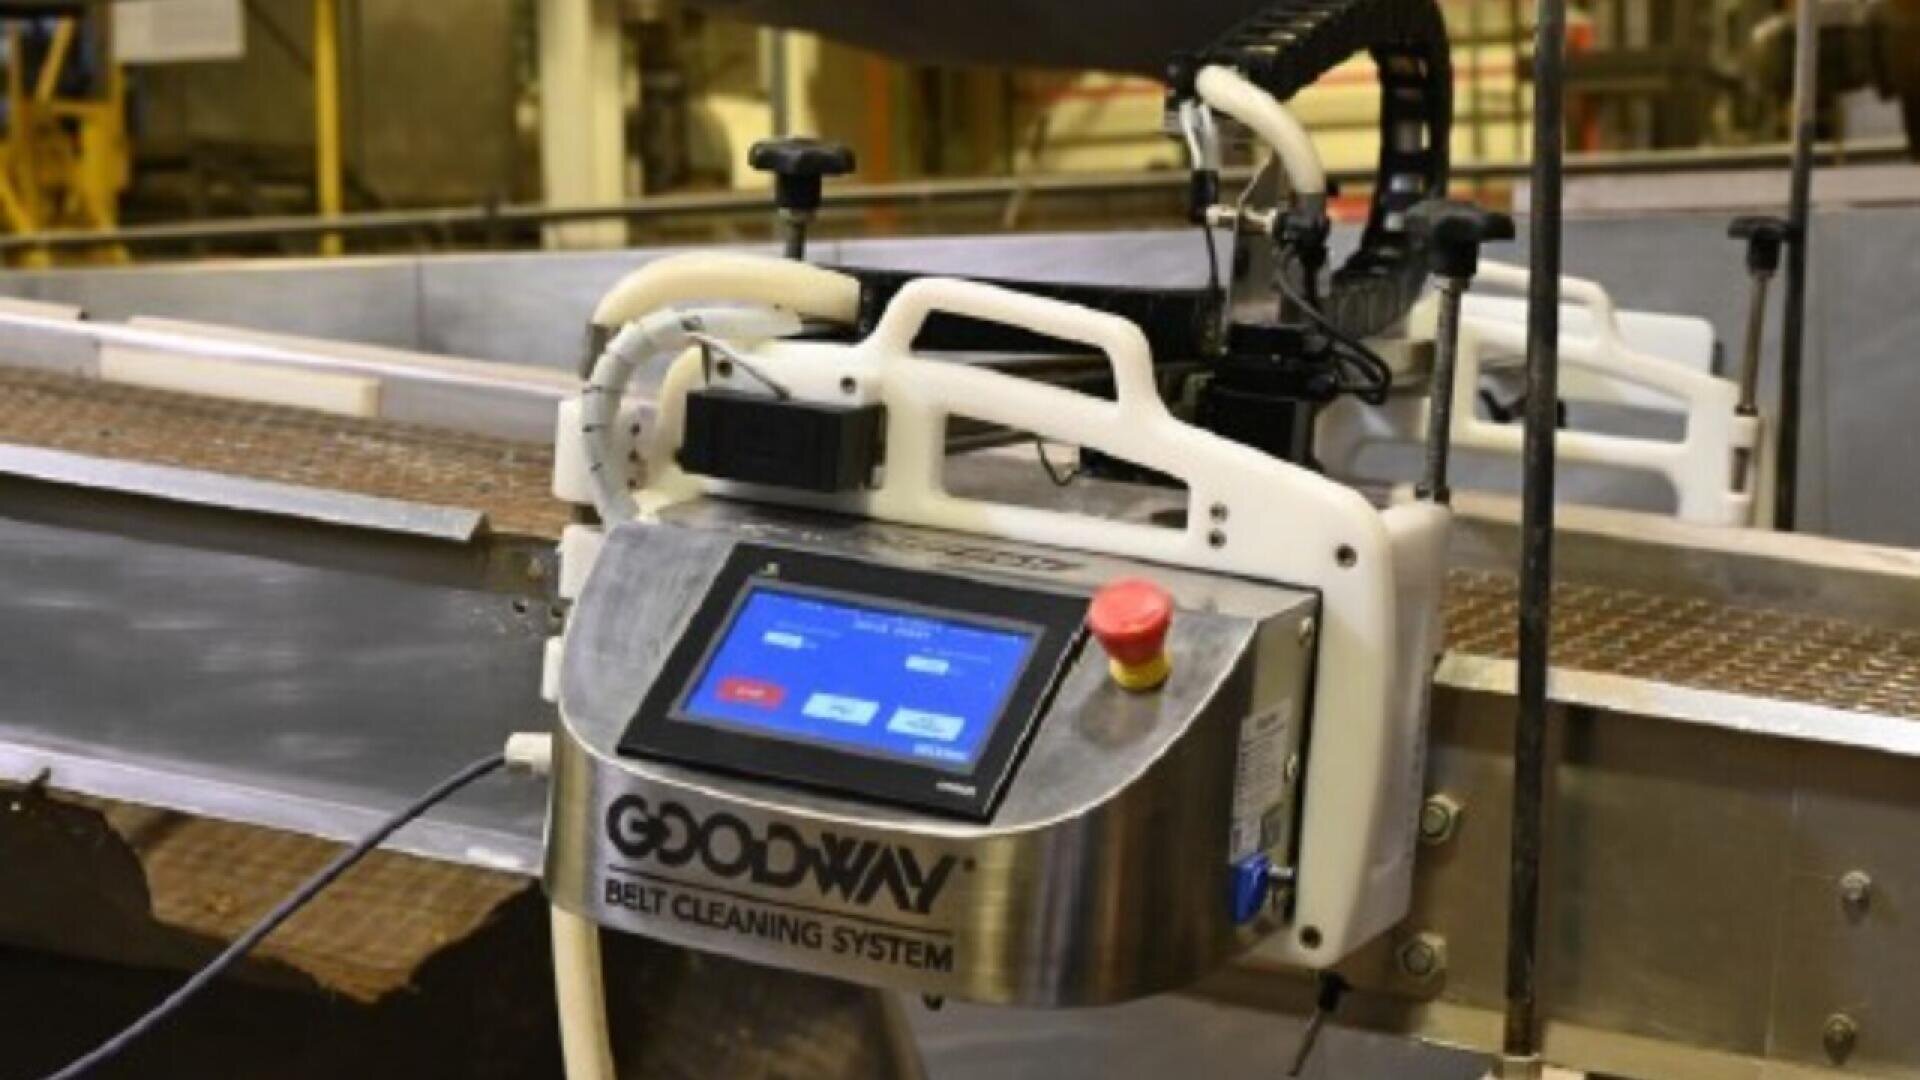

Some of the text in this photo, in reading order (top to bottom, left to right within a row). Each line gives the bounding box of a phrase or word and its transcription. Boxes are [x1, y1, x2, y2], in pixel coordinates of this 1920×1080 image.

[606, 794, 956, 914] GOODWAY
[605, 879, 954, 972] BELT CLEANING SYSTEM
